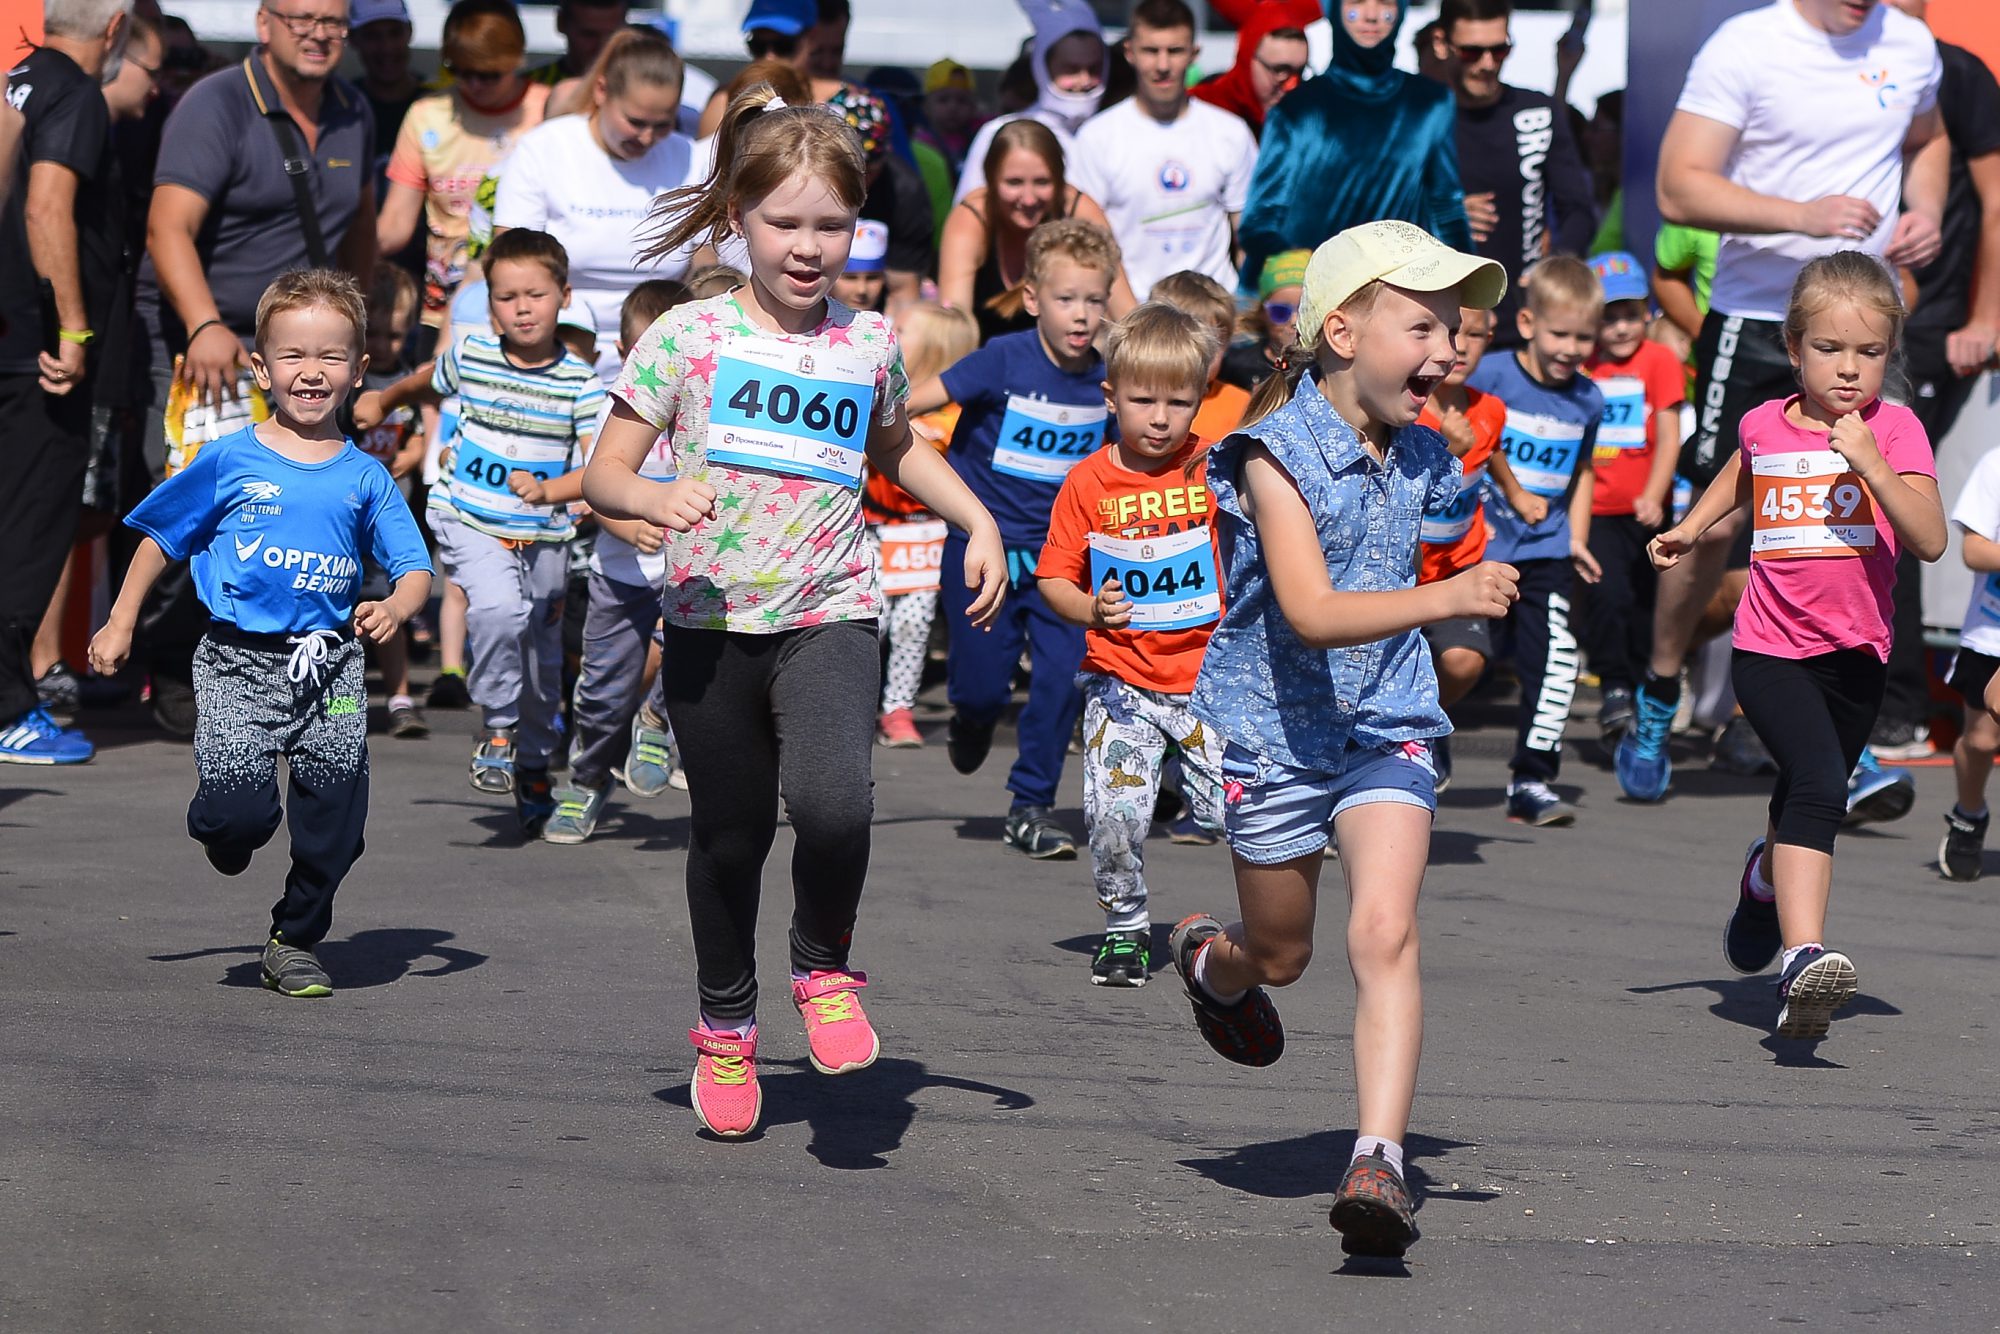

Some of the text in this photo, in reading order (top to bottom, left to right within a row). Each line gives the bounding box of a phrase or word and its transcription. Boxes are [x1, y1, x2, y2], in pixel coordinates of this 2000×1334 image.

[1513, 106, 1553, 275] BROOKLY
[728, 379, 859, 439] 4060
[1601, 404, 1632, 423] 37
[1012, 425, 1096, 457] 4022
[1502, 436, 1569, 469] 4047
[465, 456, 549, 488] 40
[1118, 485, 1209, 524] FREE
[1761, 484, 1861, 521] 4539
[262, 546, 358, 577] ОРГХИМ
[889, 545, 943, 570] 450
[1101, 560, 1205, 598] 4044
[820, 976, 854, 988] FASHION
[703, 1039, 740, 1052] FASHION
